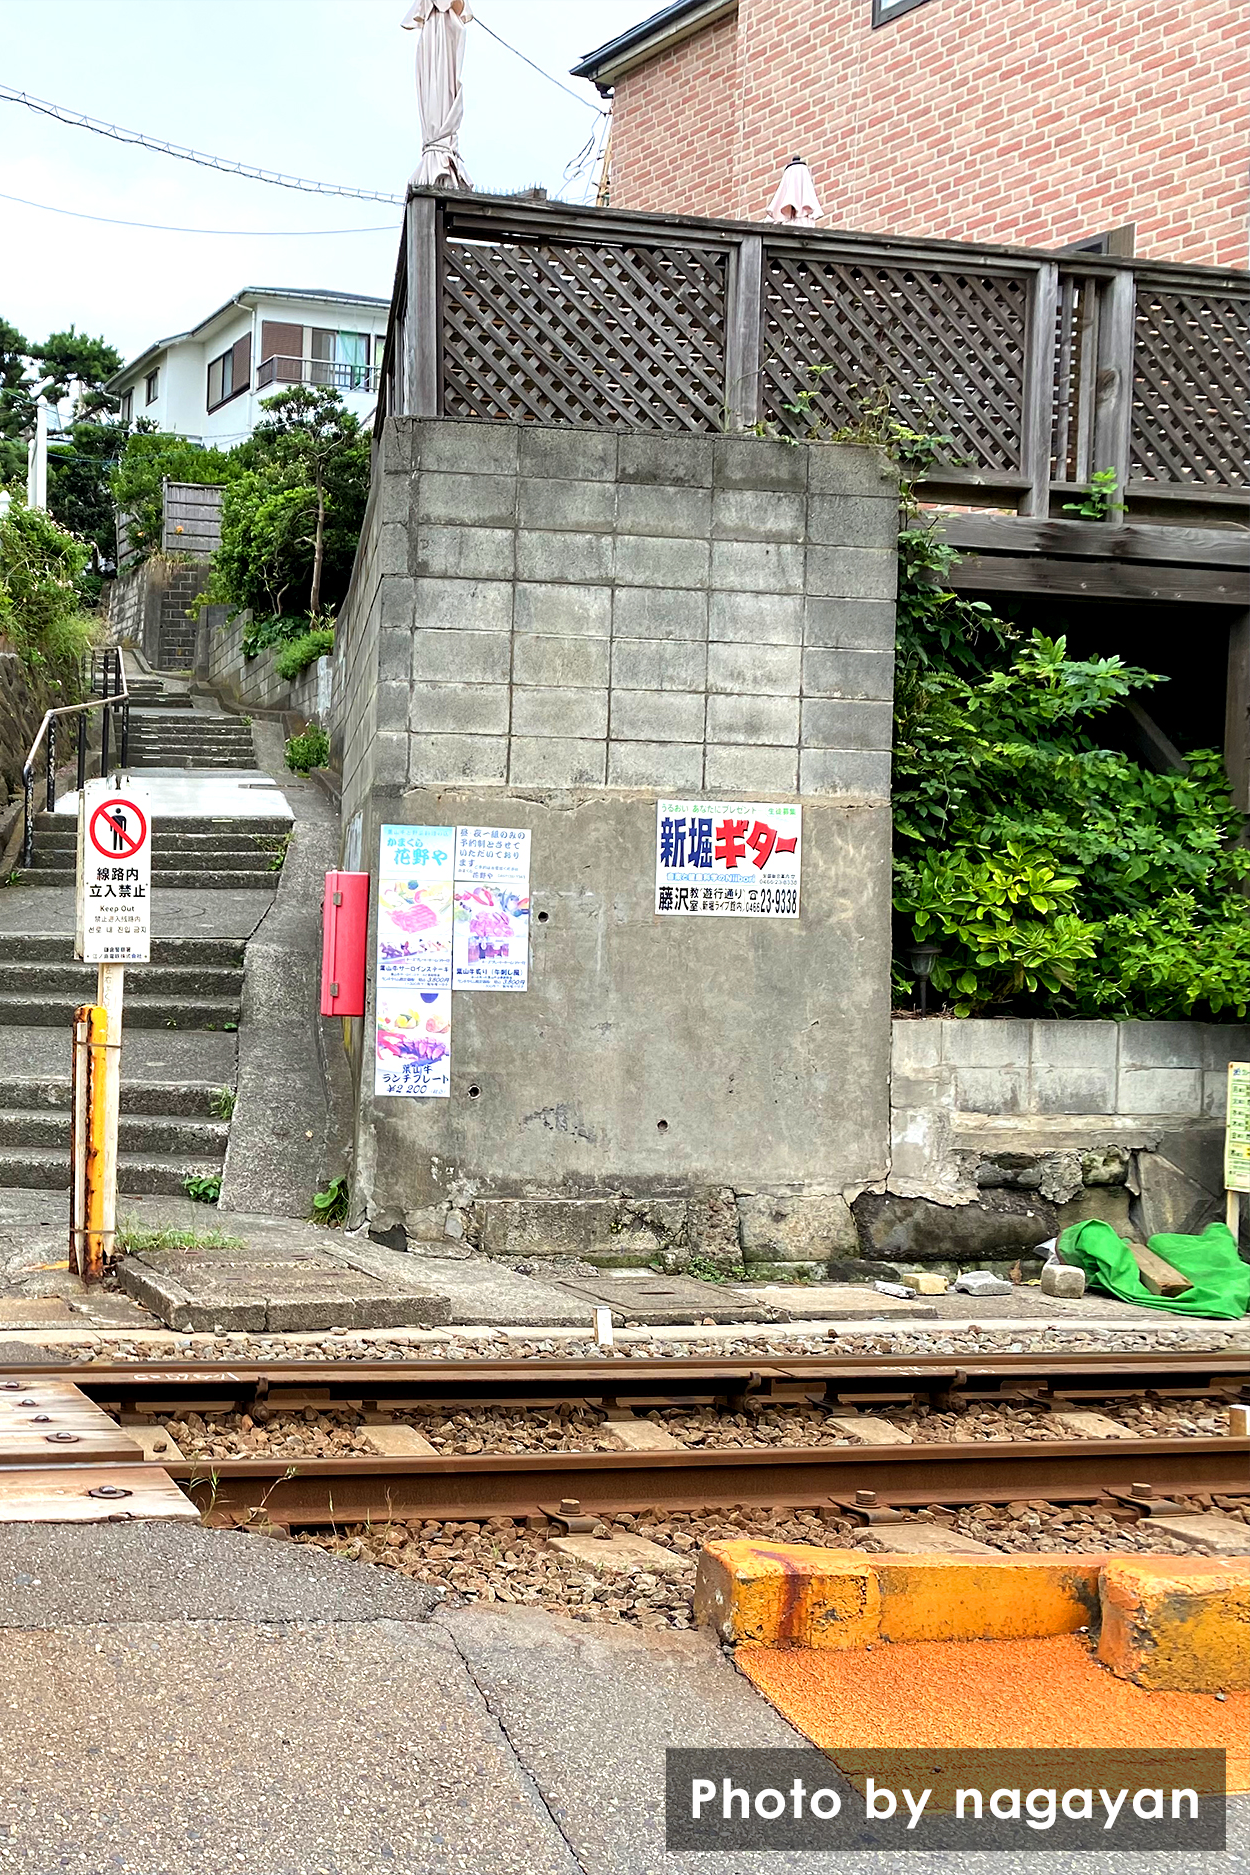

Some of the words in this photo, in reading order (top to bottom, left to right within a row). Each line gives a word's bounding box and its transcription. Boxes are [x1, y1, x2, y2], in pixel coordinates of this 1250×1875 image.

[387, 838, 424, 847] かまくら
[460, 838, 520, 849] 予約制とさせて
[660, 817, 798, 870] 新堀ギター
[394, 848, 448, 866] 花野や
[459, 849, 519, 859] いただいており
[96, 867, 139, 881] 線路内
[89, 884, 146, 898] 立入禁止
[100, 905, 119, 913] Keep
